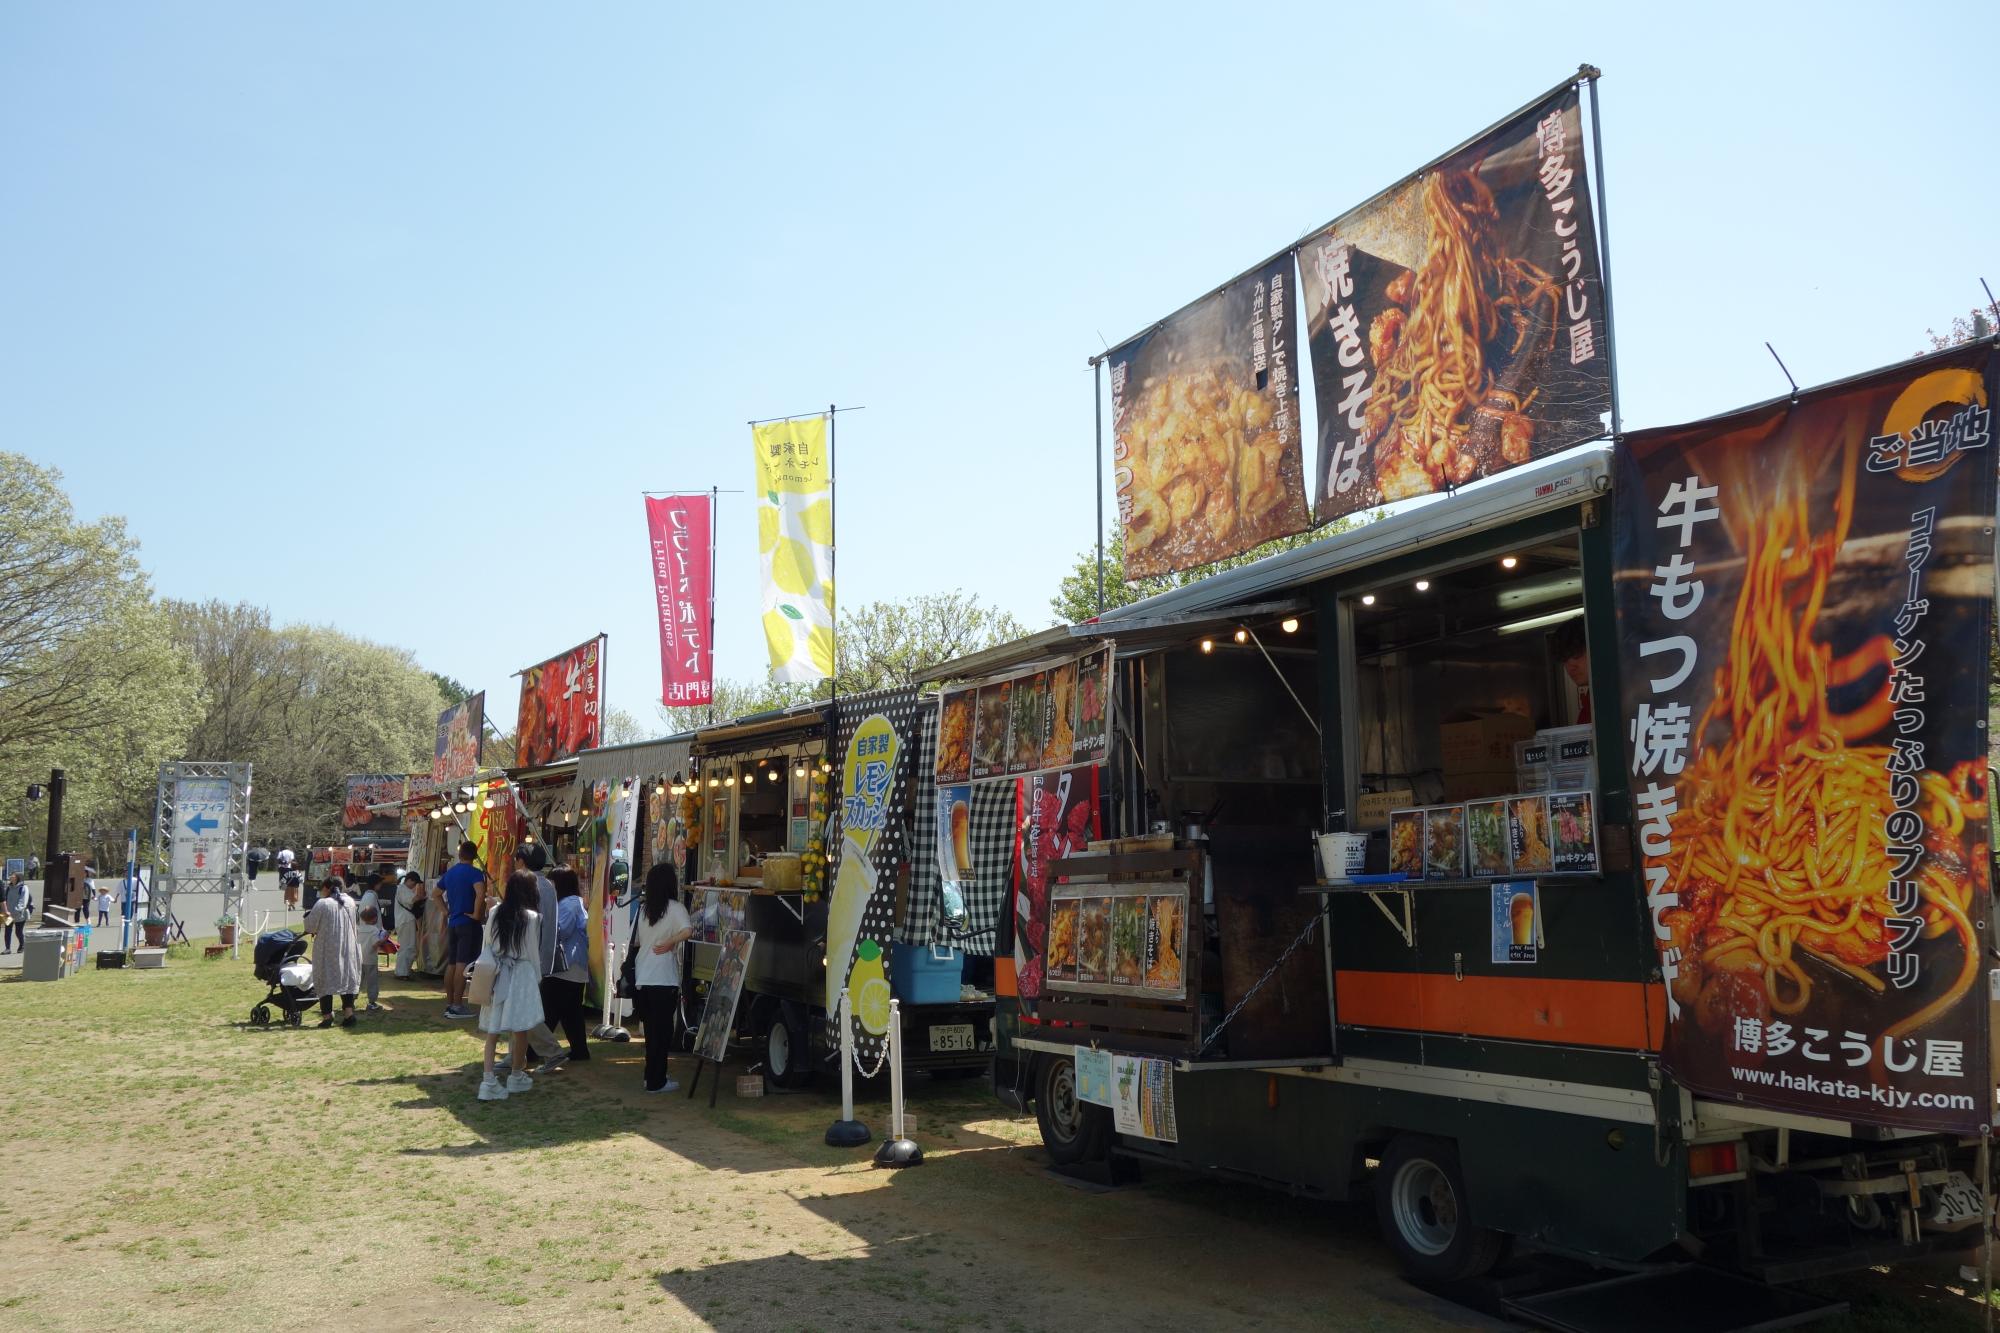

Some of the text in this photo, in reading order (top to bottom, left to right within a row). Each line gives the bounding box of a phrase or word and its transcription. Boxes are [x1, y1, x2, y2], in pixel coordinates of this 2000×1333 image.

[1535, 109, 1596, 366] 博多こうじ屋
[1252, 280, 1267, 373] 九州工場直送
[1270, 273, 1289, 445] 自家製タレで焼き上げる
[1314, 233, 1374, 499] 焼きそば
[1866, 404, 1991, 473] ご当地
[584, 673, 597, 743] 厚切り
[857, 734, 890, 756] 自家製
[1883, 506, 1937, 989] コラーゲンたっぷりのプリプリ
[854, 761, 892, 796] レモン
[180, 802, 225, 812] ネモフィラ
[841, 795, 888, 831] スカッシュ
[1566, 852, 1595, 864] 牛タン串
[1502, 882, 1512, 929] 生ビール
[940, 1034, 972, 1048] 85-16
[1732, 1016, 1965, 1079] 博多こうじ屋
[1731, 1065, 1975, 1111] www.hakata-kjy.com
